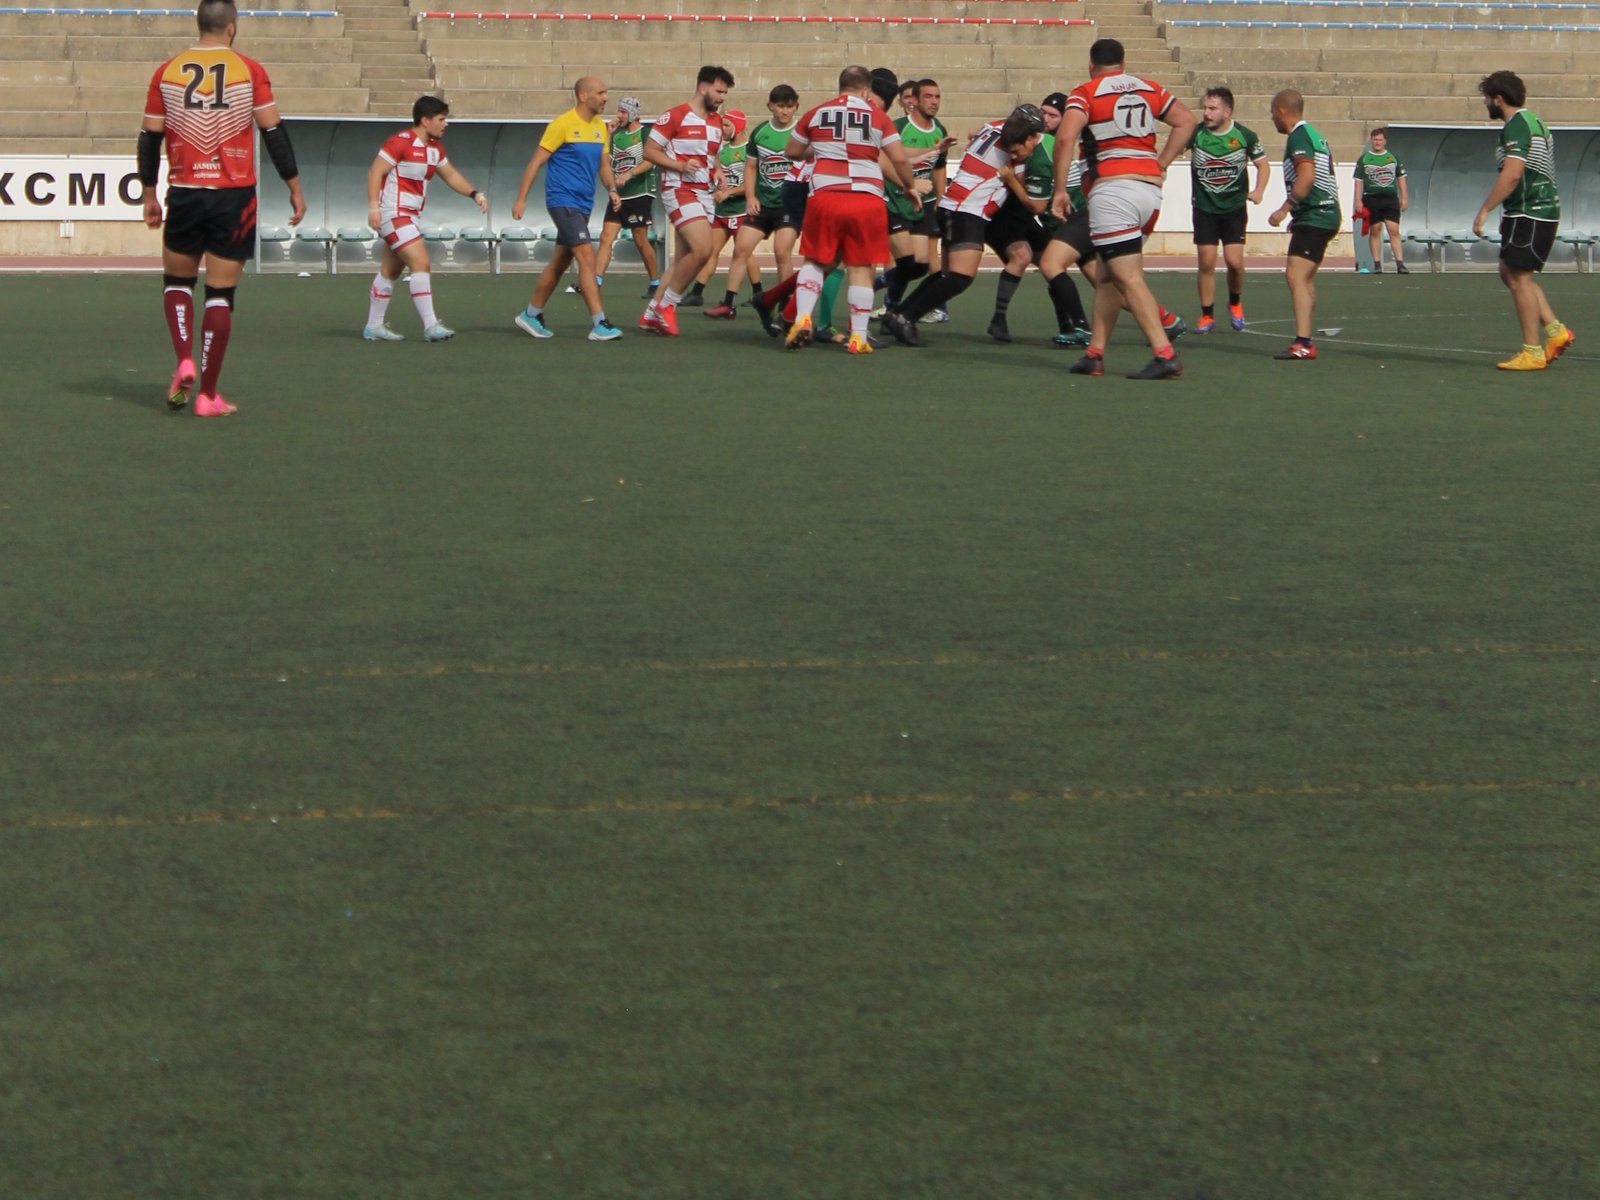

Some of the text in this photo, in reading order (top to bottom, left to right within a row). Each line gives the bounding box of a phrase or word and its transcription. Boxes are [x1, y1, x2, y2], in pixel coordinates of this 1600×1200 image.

[181, 62, 230, 111] 21
[820, 109, 871, 142] 44
[1117, 102, 1147, 129] 77
